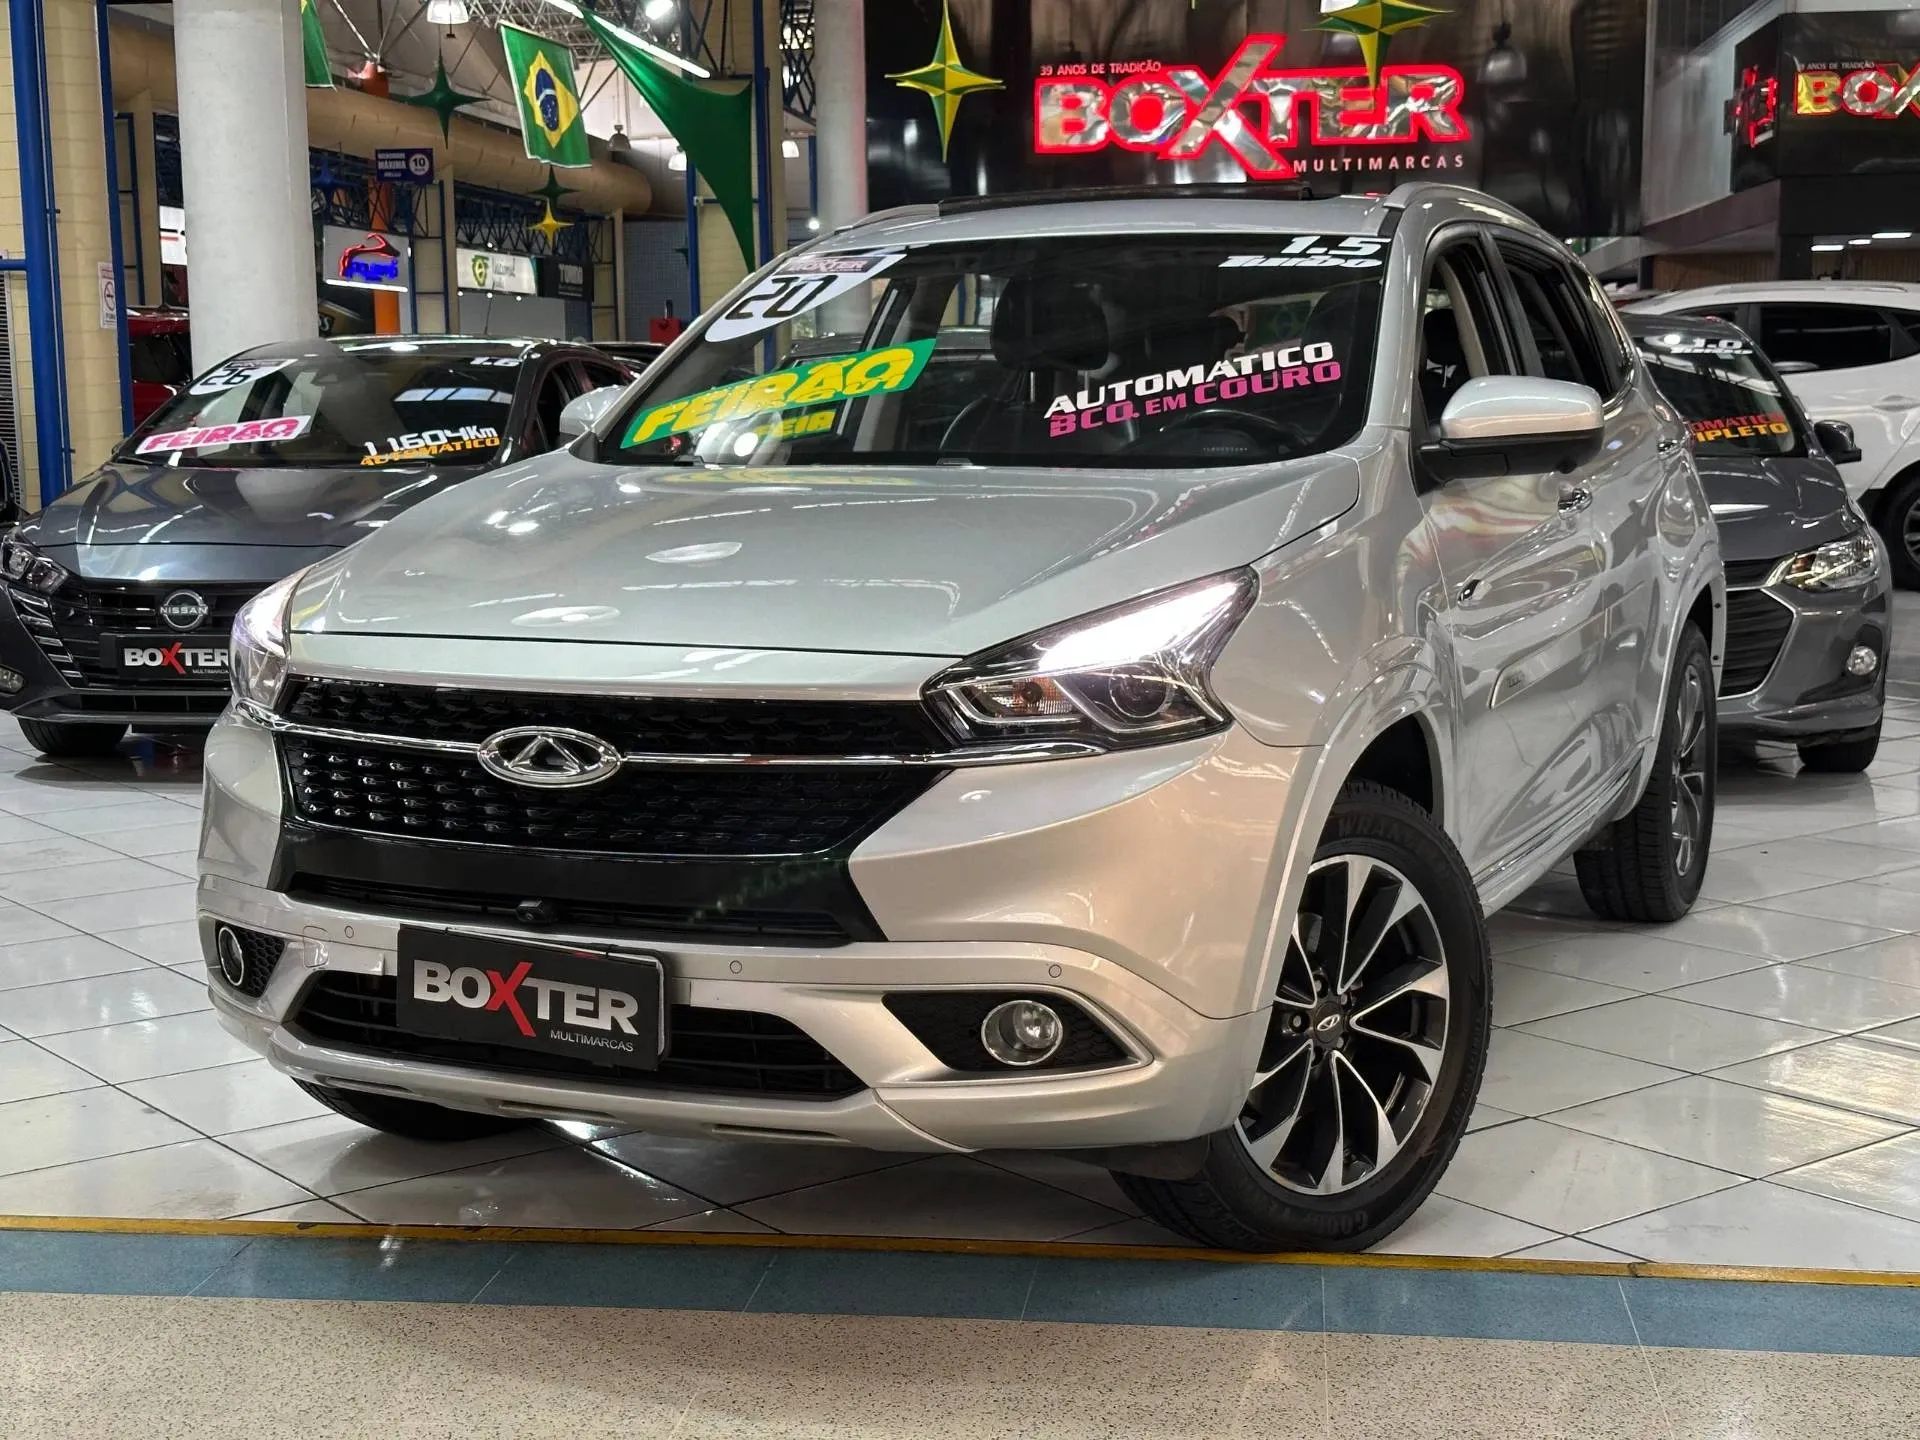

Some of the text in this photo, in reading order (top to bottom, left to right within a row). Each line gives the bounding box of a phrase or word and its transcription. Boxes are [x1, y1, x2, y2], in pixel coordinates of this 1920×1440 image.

[1040, 60, 1161, 75] 39 ANOS DE TRADIÇÃO
[1034, 33, 1471, 180] BOXTER
[412, 157, 426, 168] 10
[1293, 155, 1464, 173] MULTIMARCAS
[1280, 236, 1392, 256] 1.5
[1218, 255, 1383, 268] Turbo
[724, 274, 838, 320] 20
[1145, 392, 1188, 416] EM
[1194, 361, 1341, 404] COURO
[160, 606, 208, 616] NISSAN
[124, 642, 229, 675] BOXTER
[413, 961, 640, 1038] BOXTER
[550, 1029, 634, 1052] MULTIMARCAS
